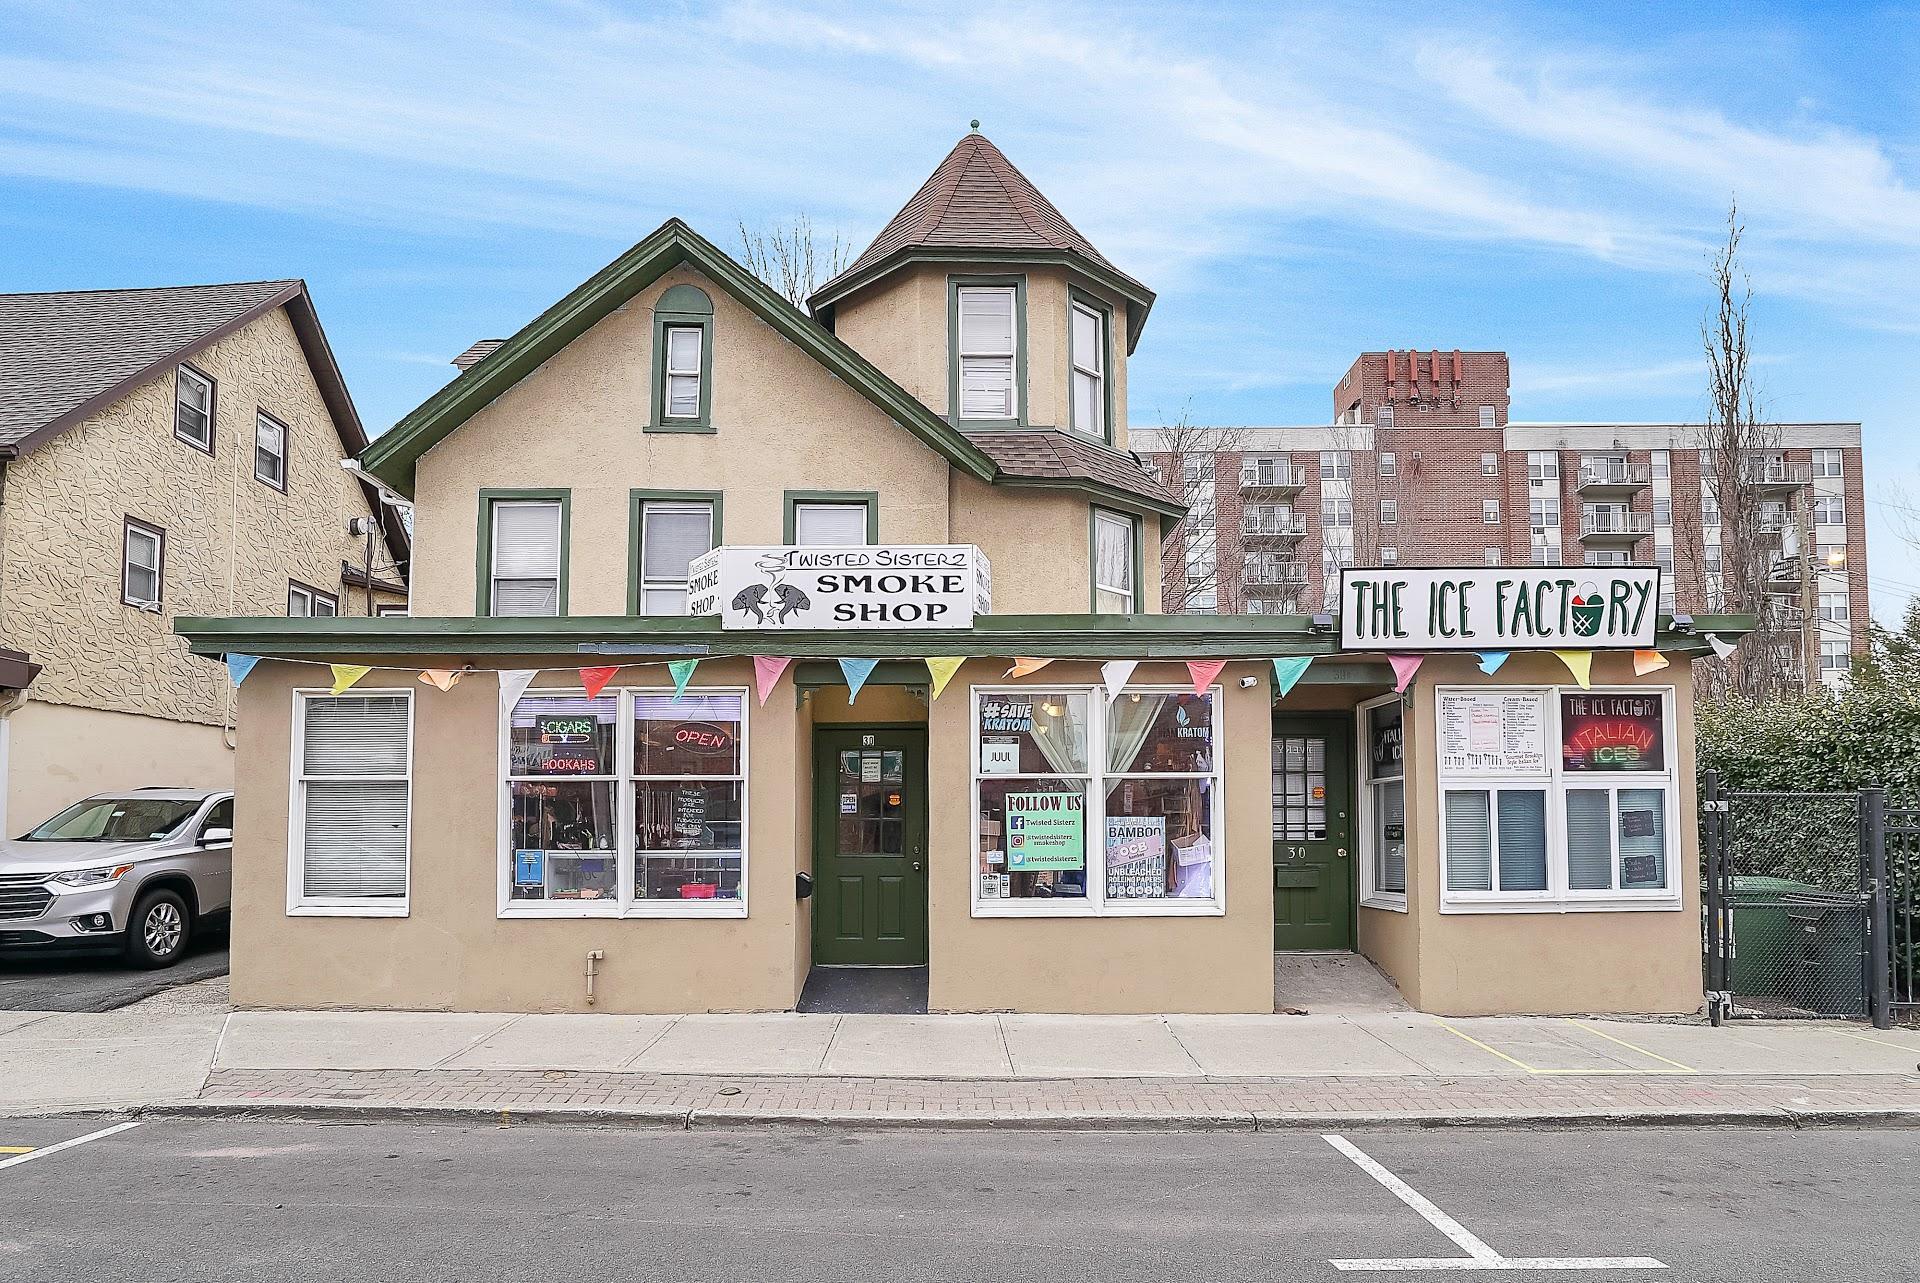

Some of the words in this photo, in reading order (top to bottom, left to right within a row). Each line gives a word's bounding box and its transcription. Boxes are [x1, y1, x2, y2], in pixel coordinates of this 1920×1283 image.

[784, 550, 870, 567] TWISTED
[689, 569, 719, 595] SMOKE
[816, 575, 965, 594] SMOKE
[691, 594, 715, 617] SHOP
[833, 603, 949, 622] SHOP
[1350, 579, 1410, 639] THE
[1427, 579, 1477, 639] ICE
[983, 702, 1032, 719] #SAVE
[1569, 698, 1588, 716] THE
[1591, 699, 1607, 716] ICE
[546, 721, 592, 734] CIGARS
[983, 718, 1032, 732] KRATOM
[1177, 727, 1210, 738] KRATOM
[675, 729, 726, 748] OPEN
[863, 736, 874, 746] 30
[1574, 723, 1654, 751] ITALIAN
[990, 751, 1011, 762] JUUL
[1593, 745, 1641, 762] ICES
[541, 758, 596, 771] HOOKAHS
[1007, 794, 1062, 812] FOLLOW
[1066, 794, 1082, 811] US
[1108, 827, 1161, 838] BAMBOO
[1120, 842, 1148, 857] OCB
[1287, 846, 1306, 859] 30
[1108, 868, 1162, 876] UNBLEACHED
